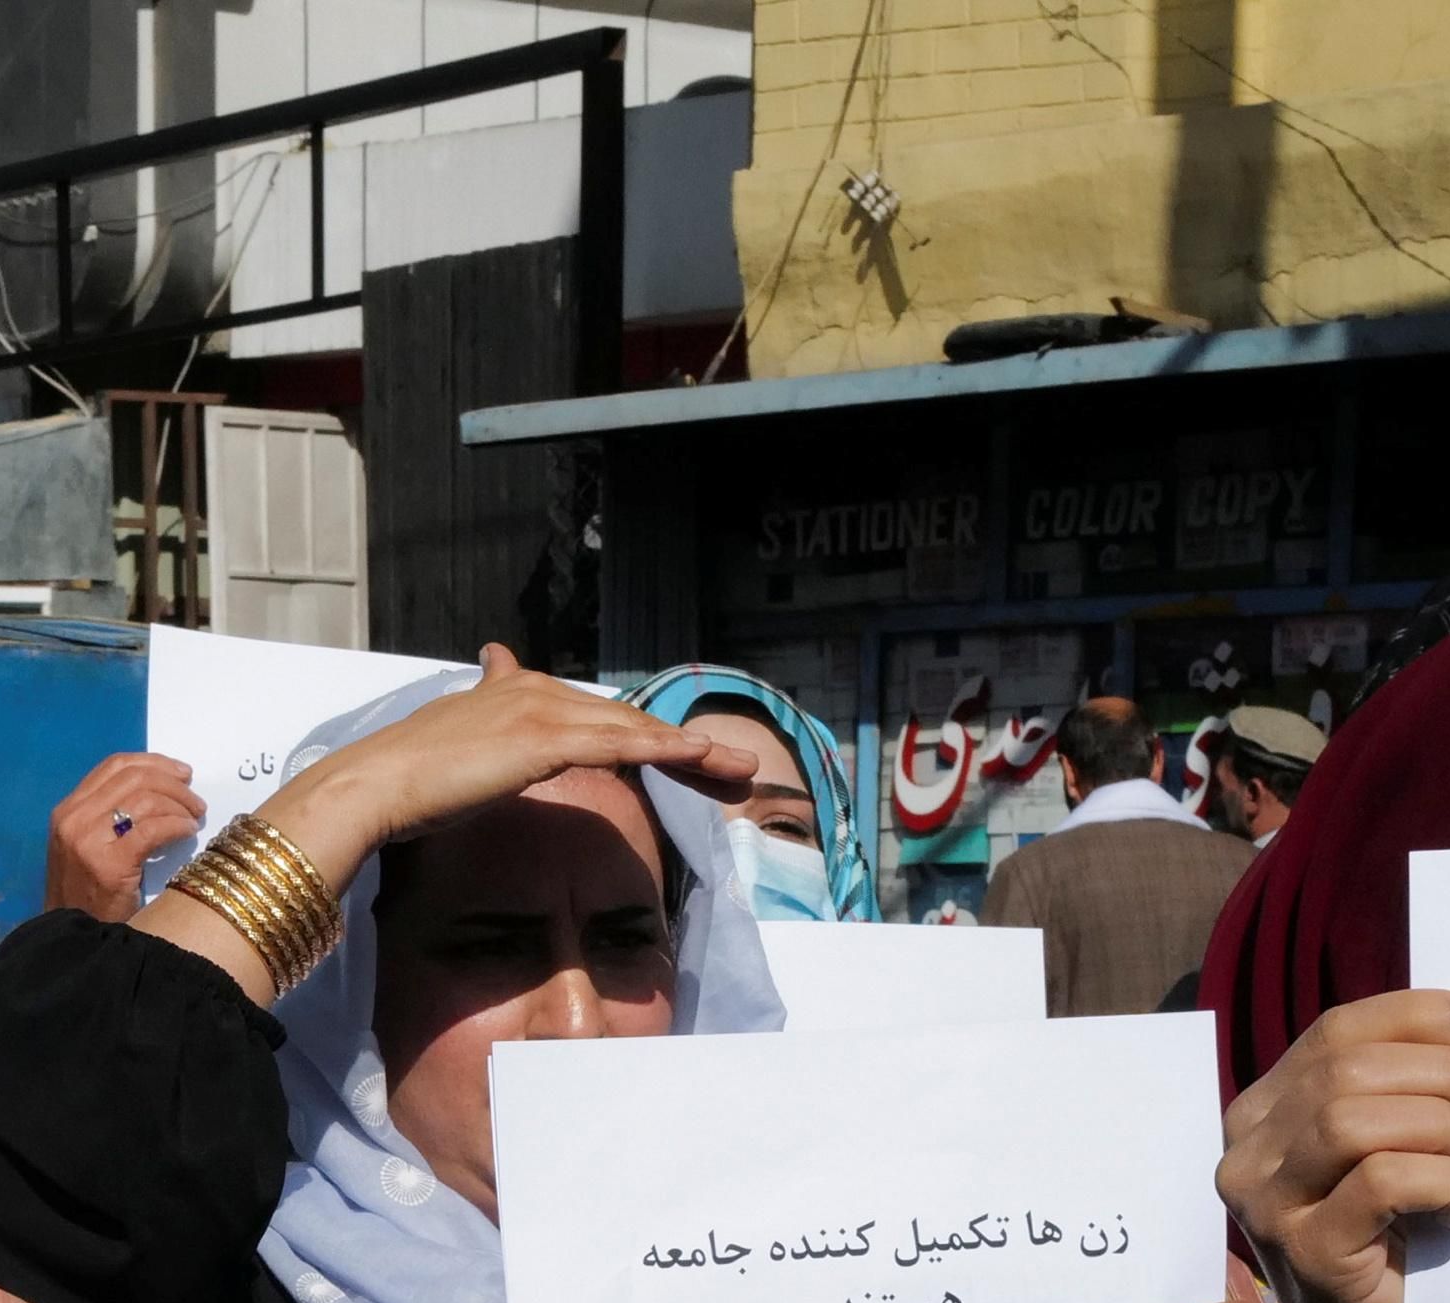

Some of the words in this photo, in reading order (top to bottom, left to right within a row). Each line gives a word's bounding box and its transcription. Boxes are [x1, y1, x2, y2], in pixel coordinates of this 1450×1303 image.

[757, 495, 980, 561] STATIONER
[1025, 481, 1164, 540] COLOR
[1186, 467, 1317, 528] COPY
[642, 1229, 752, 1275] جامعه
[769, 1220, 876, 1262] کننده
[894, 1213, 1010, 1268] تکمیل
